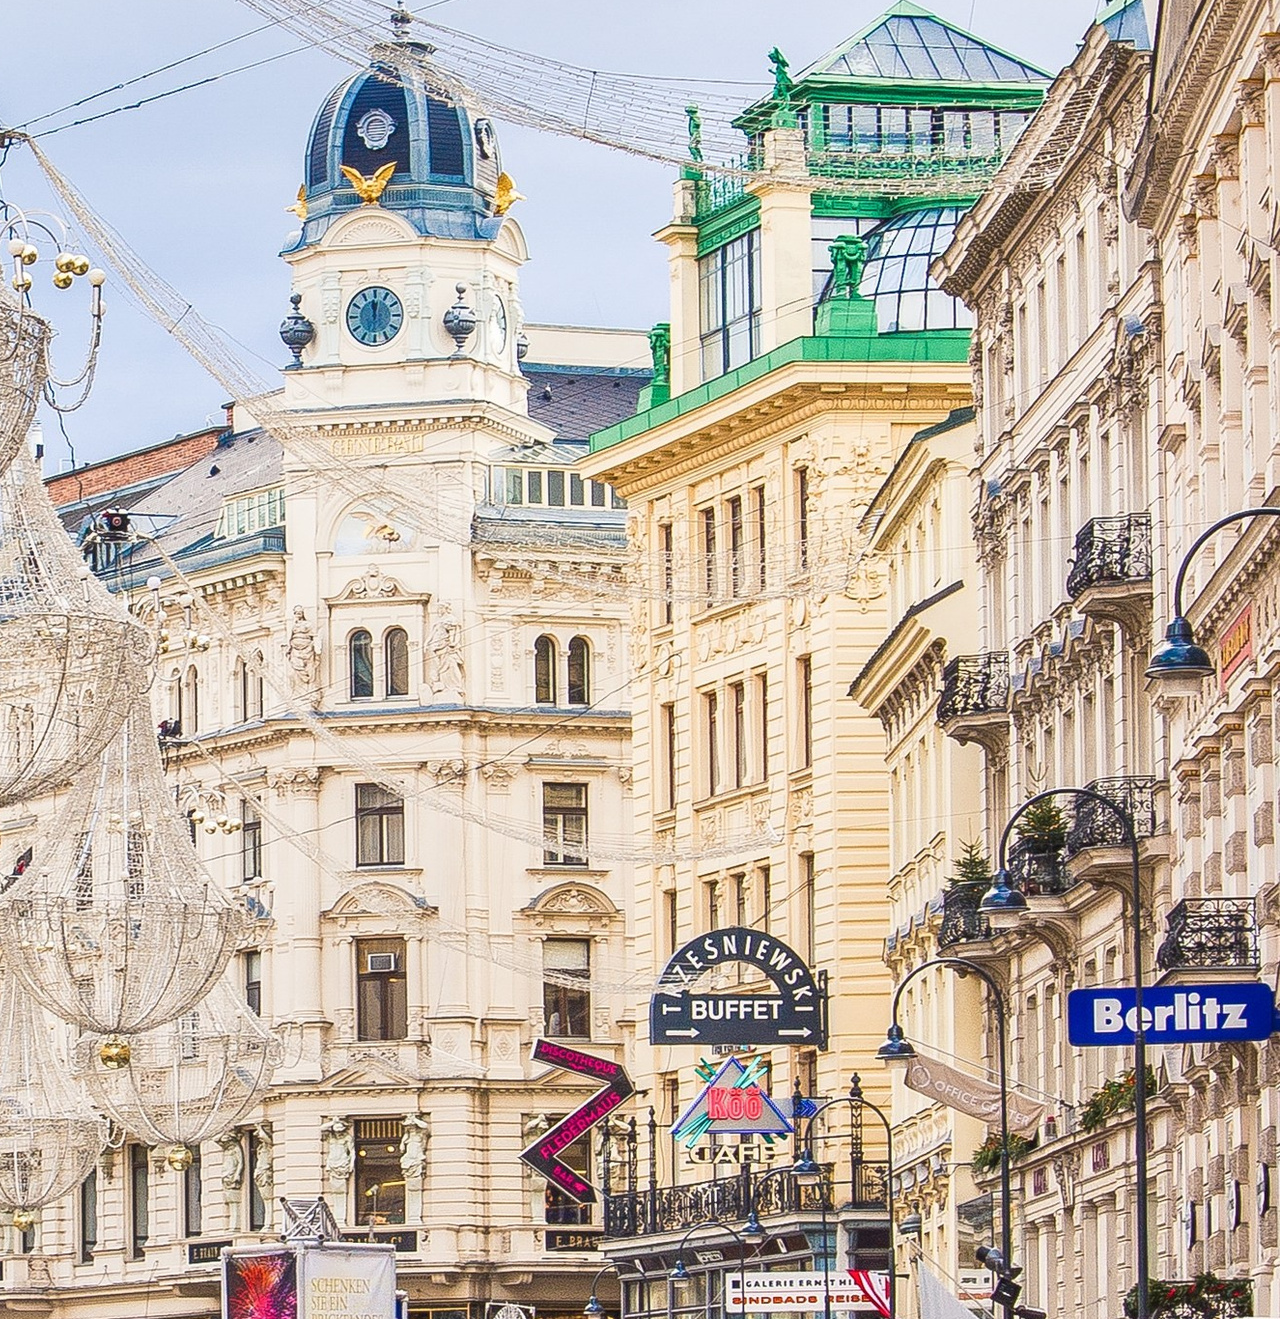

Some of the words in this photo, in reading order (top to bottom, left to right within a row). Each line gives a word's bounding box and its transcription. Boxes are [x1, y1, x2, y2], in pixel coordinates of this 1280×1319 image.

[691, 999, 783, 1021] BUFFET
[1093, 992, 1248, 1033] Berlitz
[540, 1042, 617, 1075] DISCOTHEQUE
[934, 1080, 978, 1108] OFFICE
[981, 1100, 1030, 1126] CETER
[540, 1091, 621, 1160] FLEDERMAUS
[311, 1278, 370, 1294] SCHENKEN
[746, 1280, 795, 1288] GALERIE
[311, 1296, 327, 1311] SIE
[330, 1295, 348, 1310] EIN
